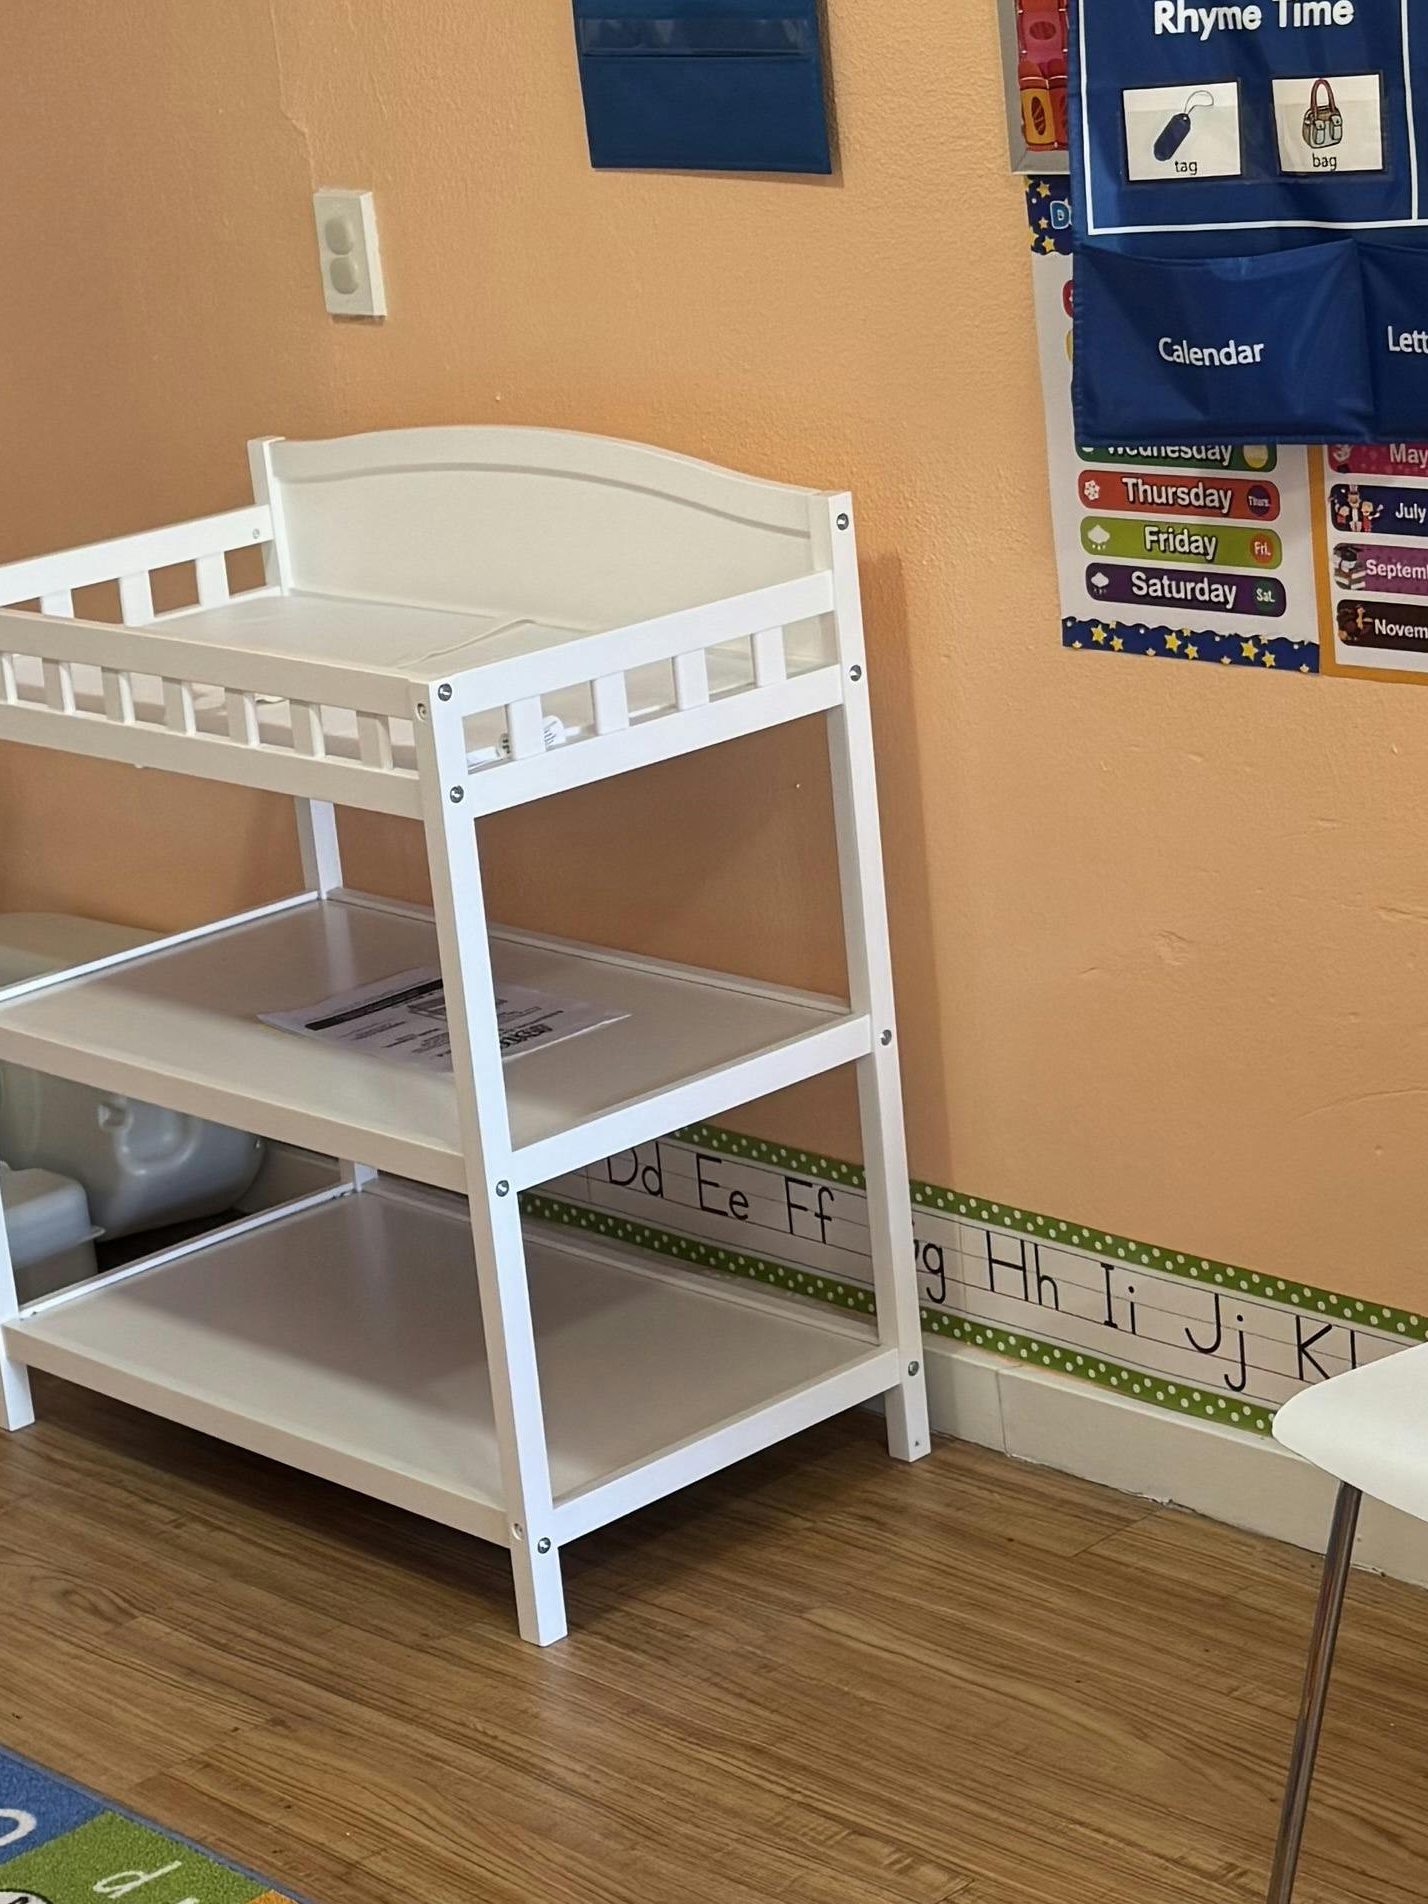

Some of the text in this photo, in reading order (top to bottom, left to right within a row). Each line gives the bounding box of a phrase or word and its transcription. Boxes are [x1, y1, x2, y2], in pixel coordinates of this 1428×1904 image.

[1173, 157, 1198, 177] tag
[1311, 149, 1338, 172] bag
[1158, 337, 1265, 366] Calendar
[1389, 443, 1428, 466] May
[1122, 477, 1232, 513] Thursday
[1395, 503, 1426, 523] July
[1144, 526, 1216, 560] Friday
[1131, 571, 1236, 609] Saturday
[694, 1151, 751, 1223] Ee
[784, 1176, 835, 1244] Ff
[986, 1230, 1060, 1312] Hh
[1100, 1263, 1137, 1338] Ii
[1184, 1292, 1246, 1392] Jj
